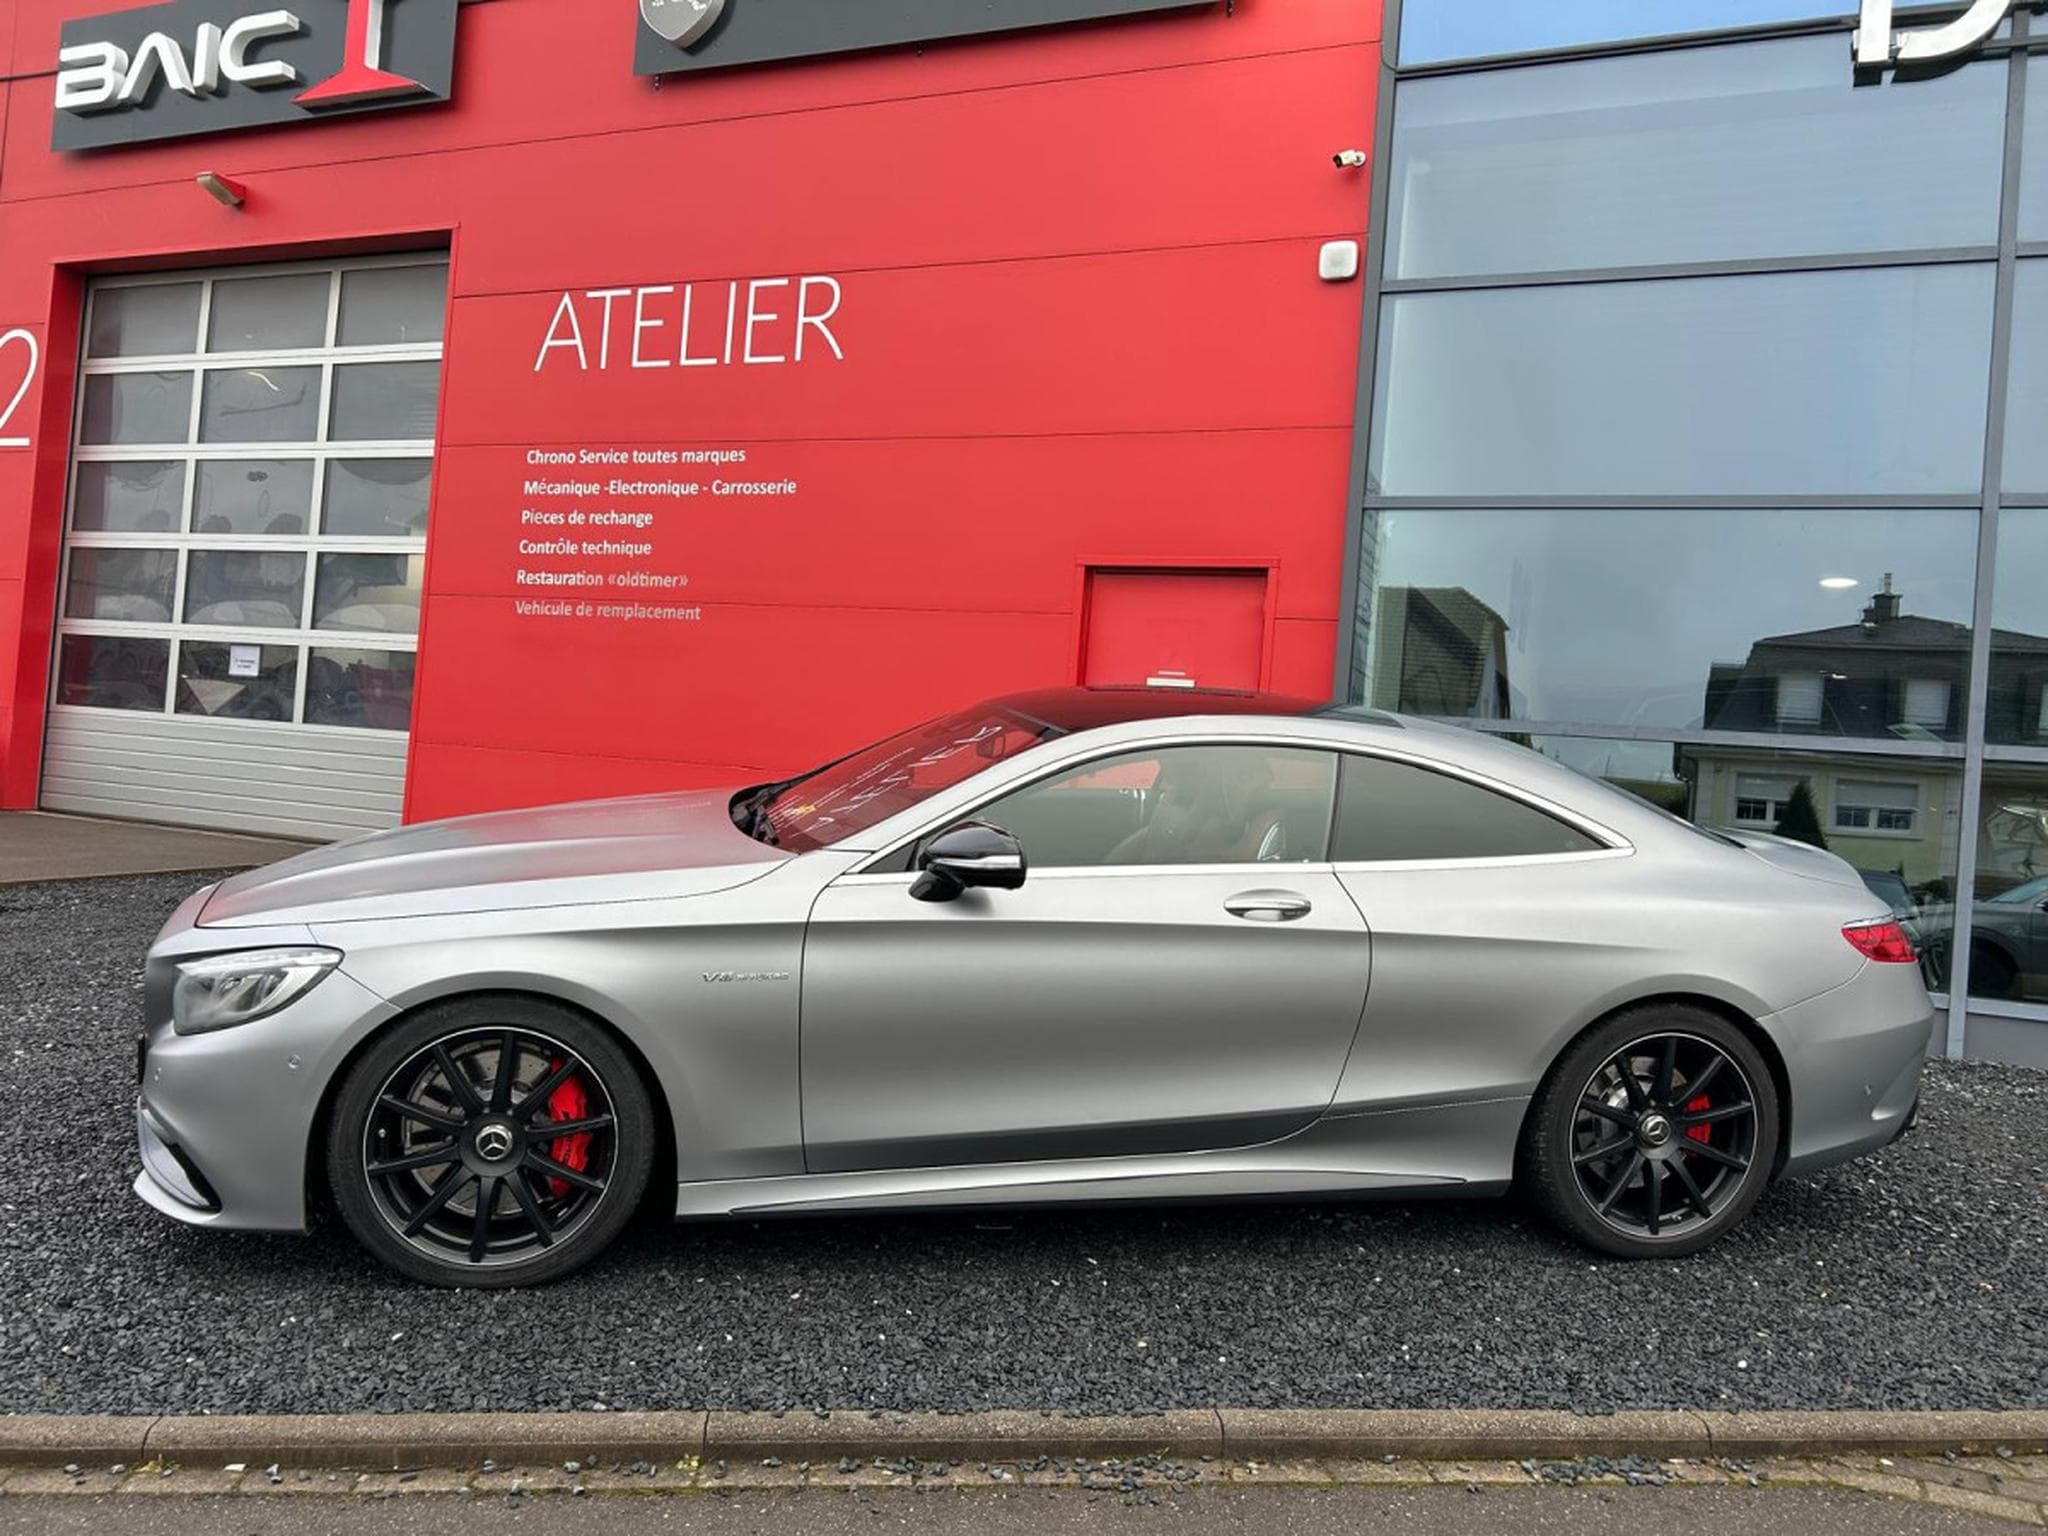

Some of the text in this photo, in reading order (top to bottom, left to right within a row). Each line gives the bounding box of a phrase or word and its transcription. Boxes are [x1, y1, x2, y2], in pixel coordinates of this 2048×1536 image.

[55, 9, 299, 111] BAIC
[533, 274, 844, 373] ATELIER
[526, 447, 747, 468] Chrono Service toutes marques
[523, 478, 601, 499] Mécanique
[711, 477, 798, 497] Carrosserie
[567, 509, 587, 526] de
[588, 509, 654, 529] rechange
[518, 537, 653, 559] Contrôle technique
[515, 569, 604, 587] Restauration
[575, 601, 594, 617] de
[596, 602, 702, 621] remplacement
